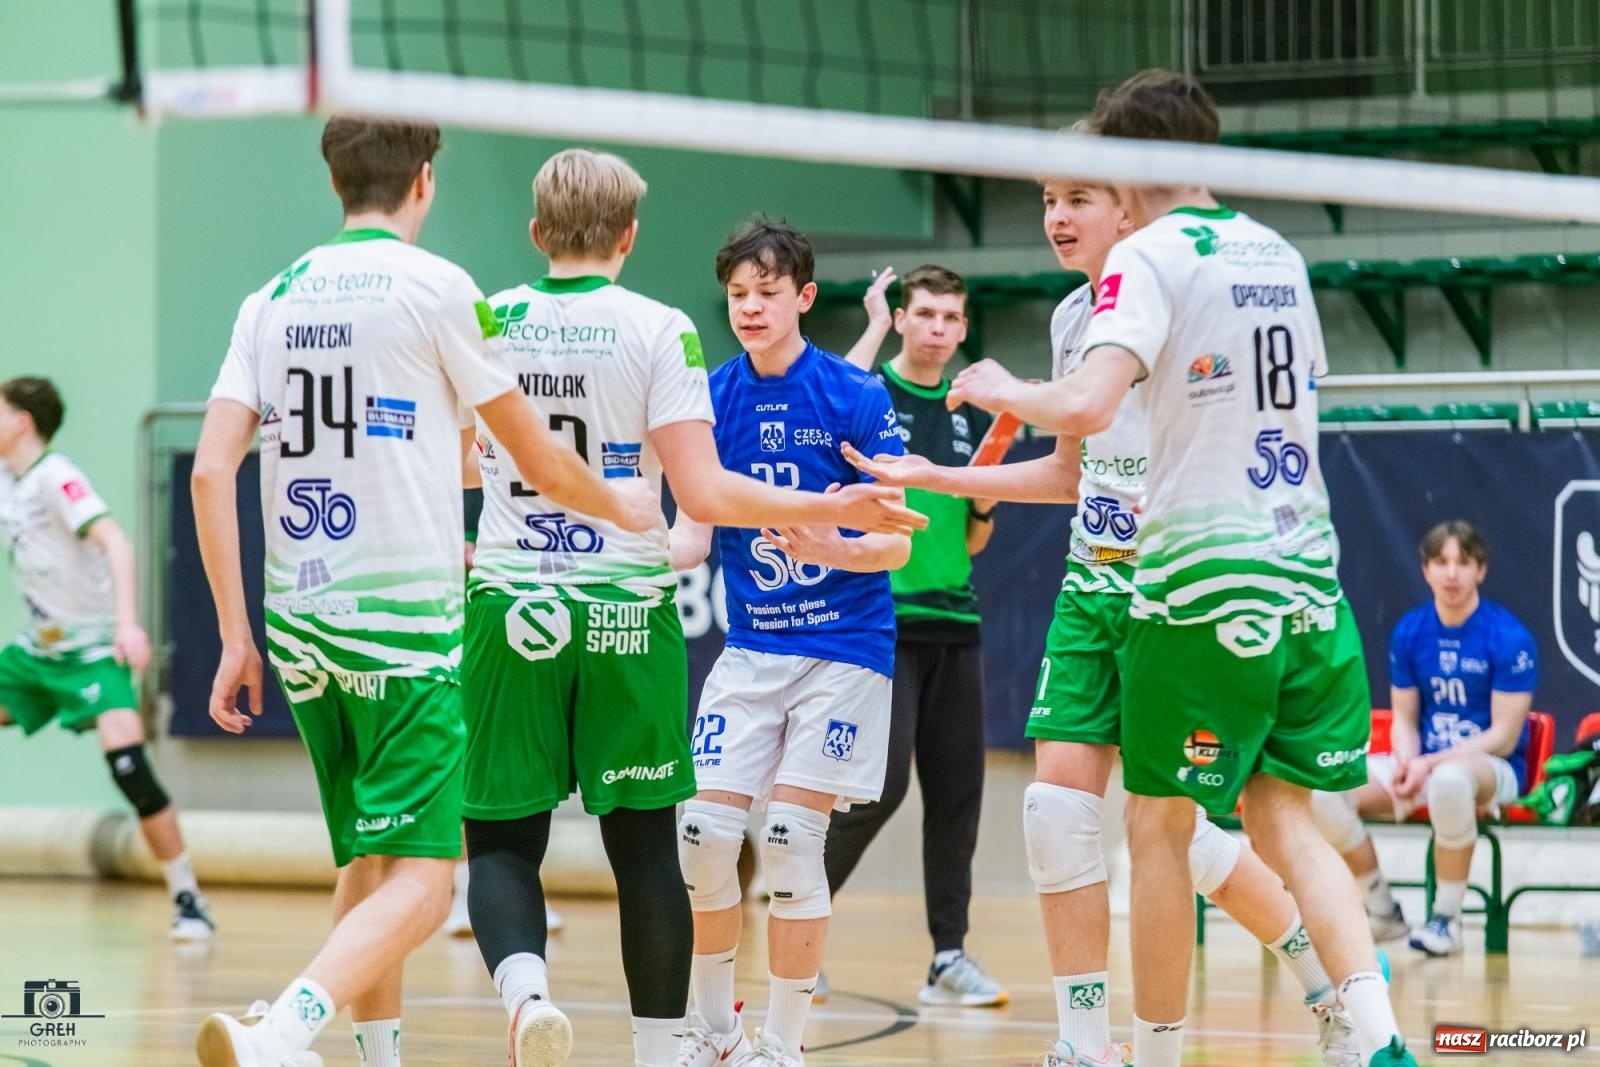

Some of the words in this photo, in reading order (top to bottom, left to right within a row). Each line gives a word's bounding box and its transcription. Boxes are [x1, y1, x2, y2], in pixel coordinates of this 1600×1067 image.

[285, 322, 353, 350] SIWECKI
[507, 323, 617, 344] eco-team
[1251, 325, 1297, 412] 18
[518, 373, 587, 399] NTOLAK
[280, 365, 358, 459] 34
[279, 478, 357, 541] STO
[587, 603, 649, 629] SCOUT
[745, 603, 781, 615] Passion
[782, 602, 797, 614] for
[799, 599, 826, 613] glass
[752, 617, 789, 630] Passion
[790, 616, 805, 627] for
[806, 610, 840, 626] Sports
[586, 630, 650, 655] SPORT
[692, 713, 727, 755] 22
[601, 762, 675, 785] GAMINATE
